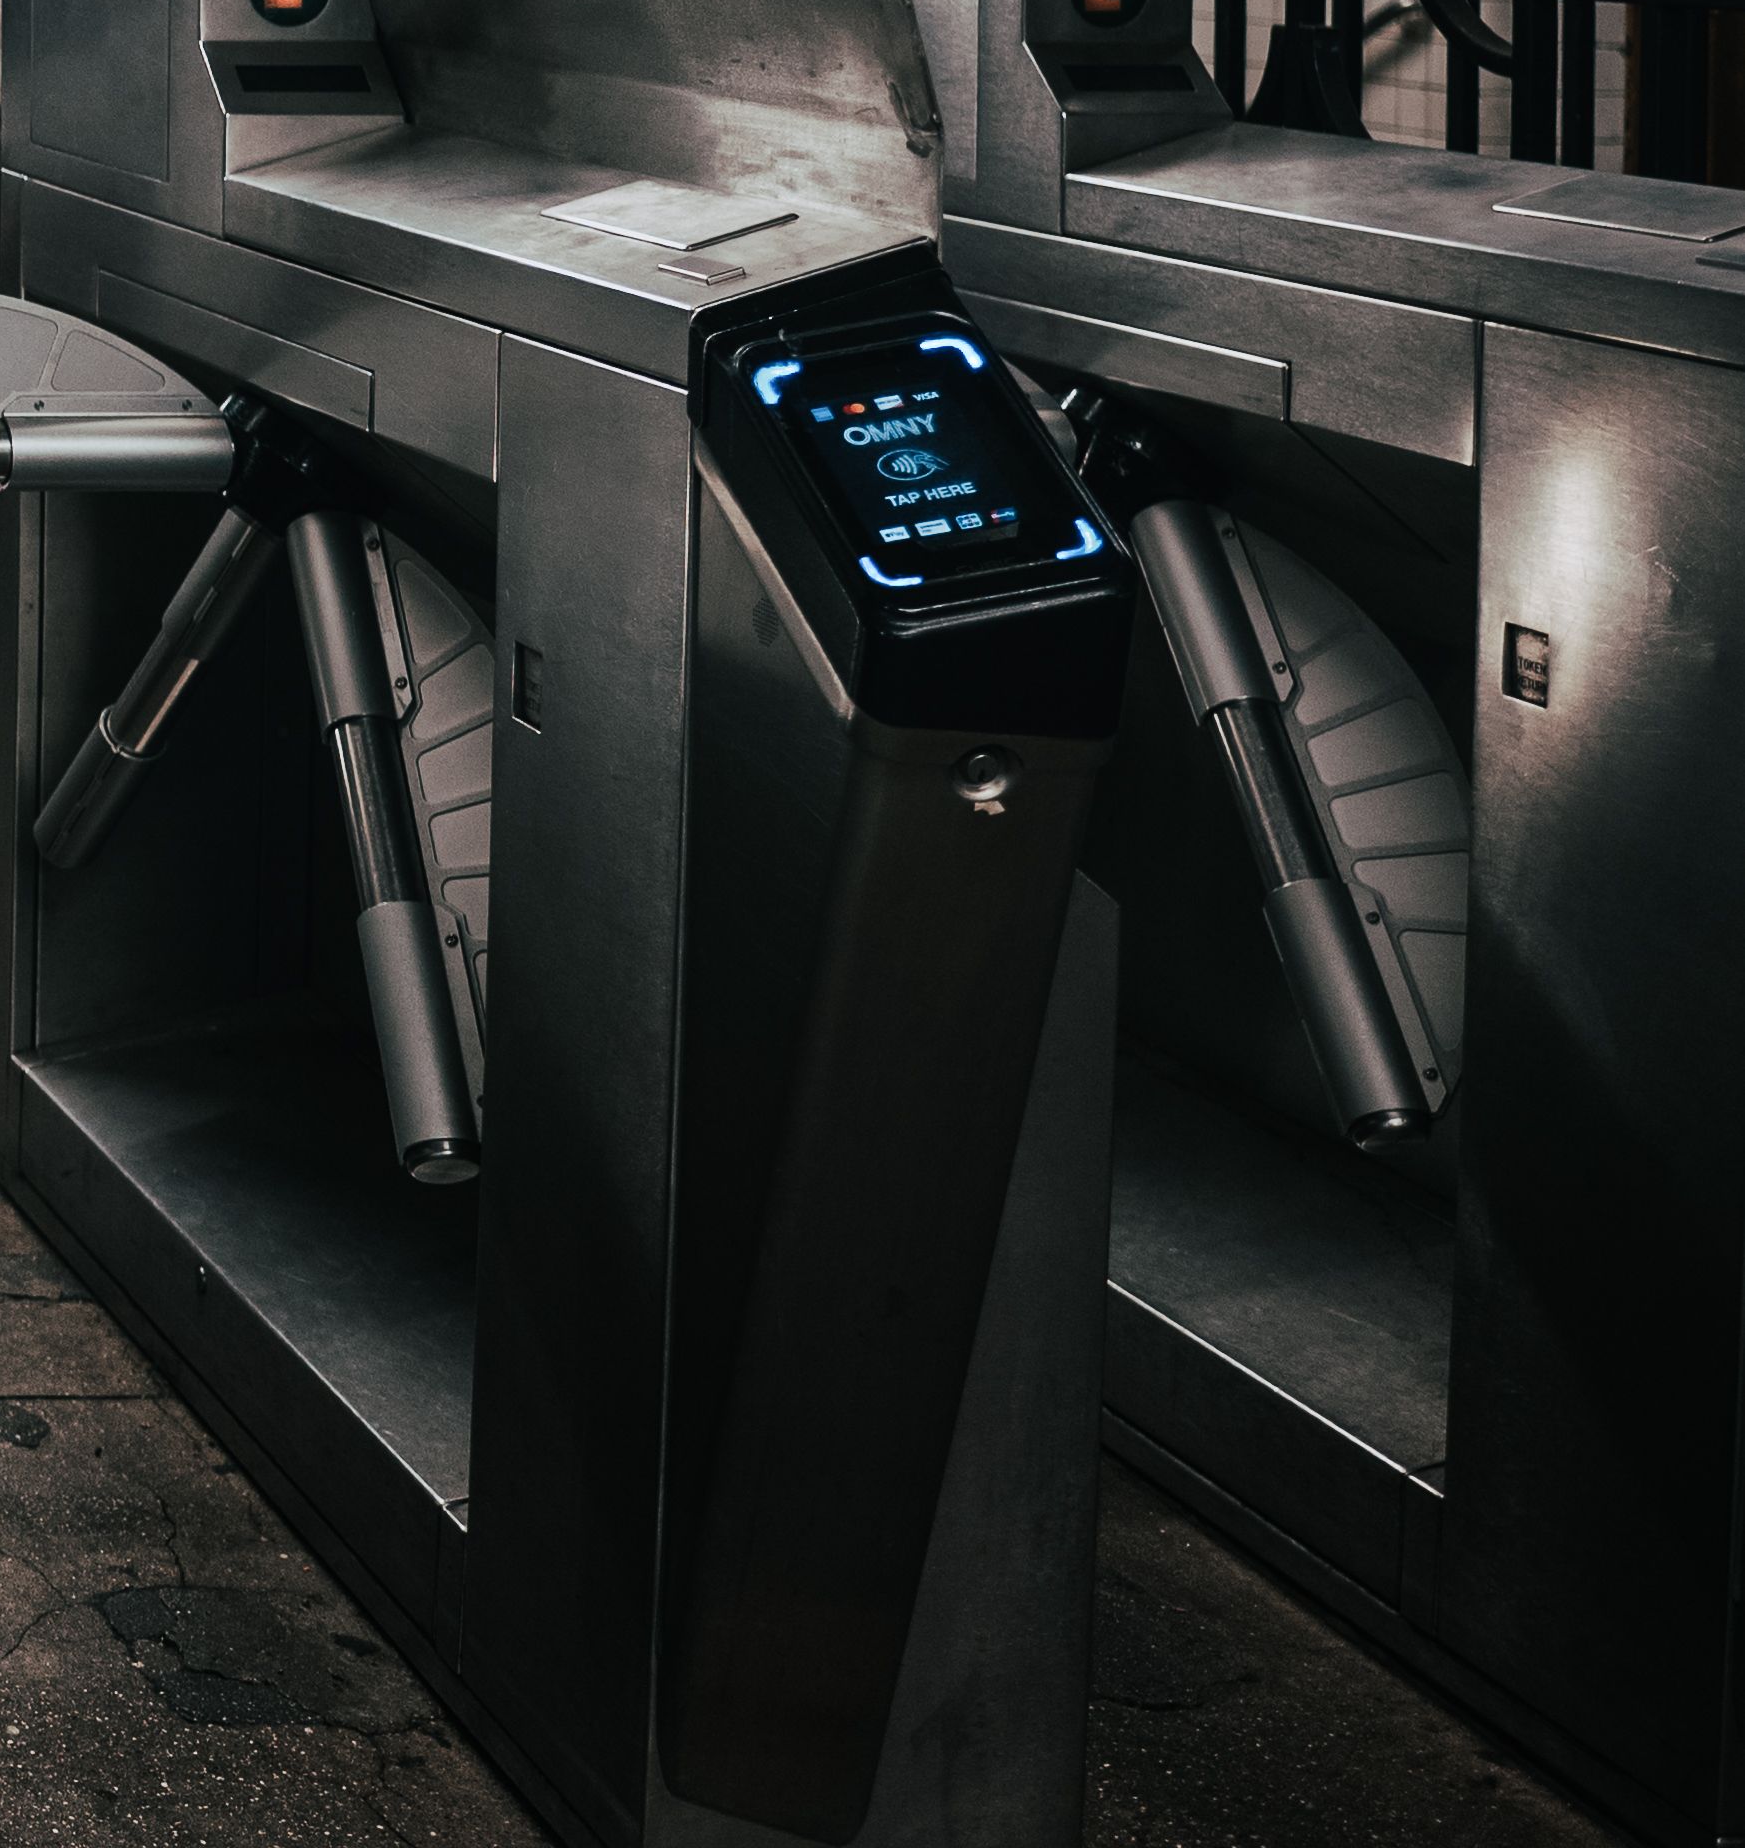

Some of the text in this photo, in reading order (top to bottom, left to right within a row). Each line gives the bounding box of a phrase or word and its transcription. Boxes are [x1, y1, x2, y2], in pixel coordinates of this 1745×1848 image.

[911, 390, 940, 403] VISA
[843, 413, 937, 446] OMNY
[885, 481, 977, 508] TAP HERE
